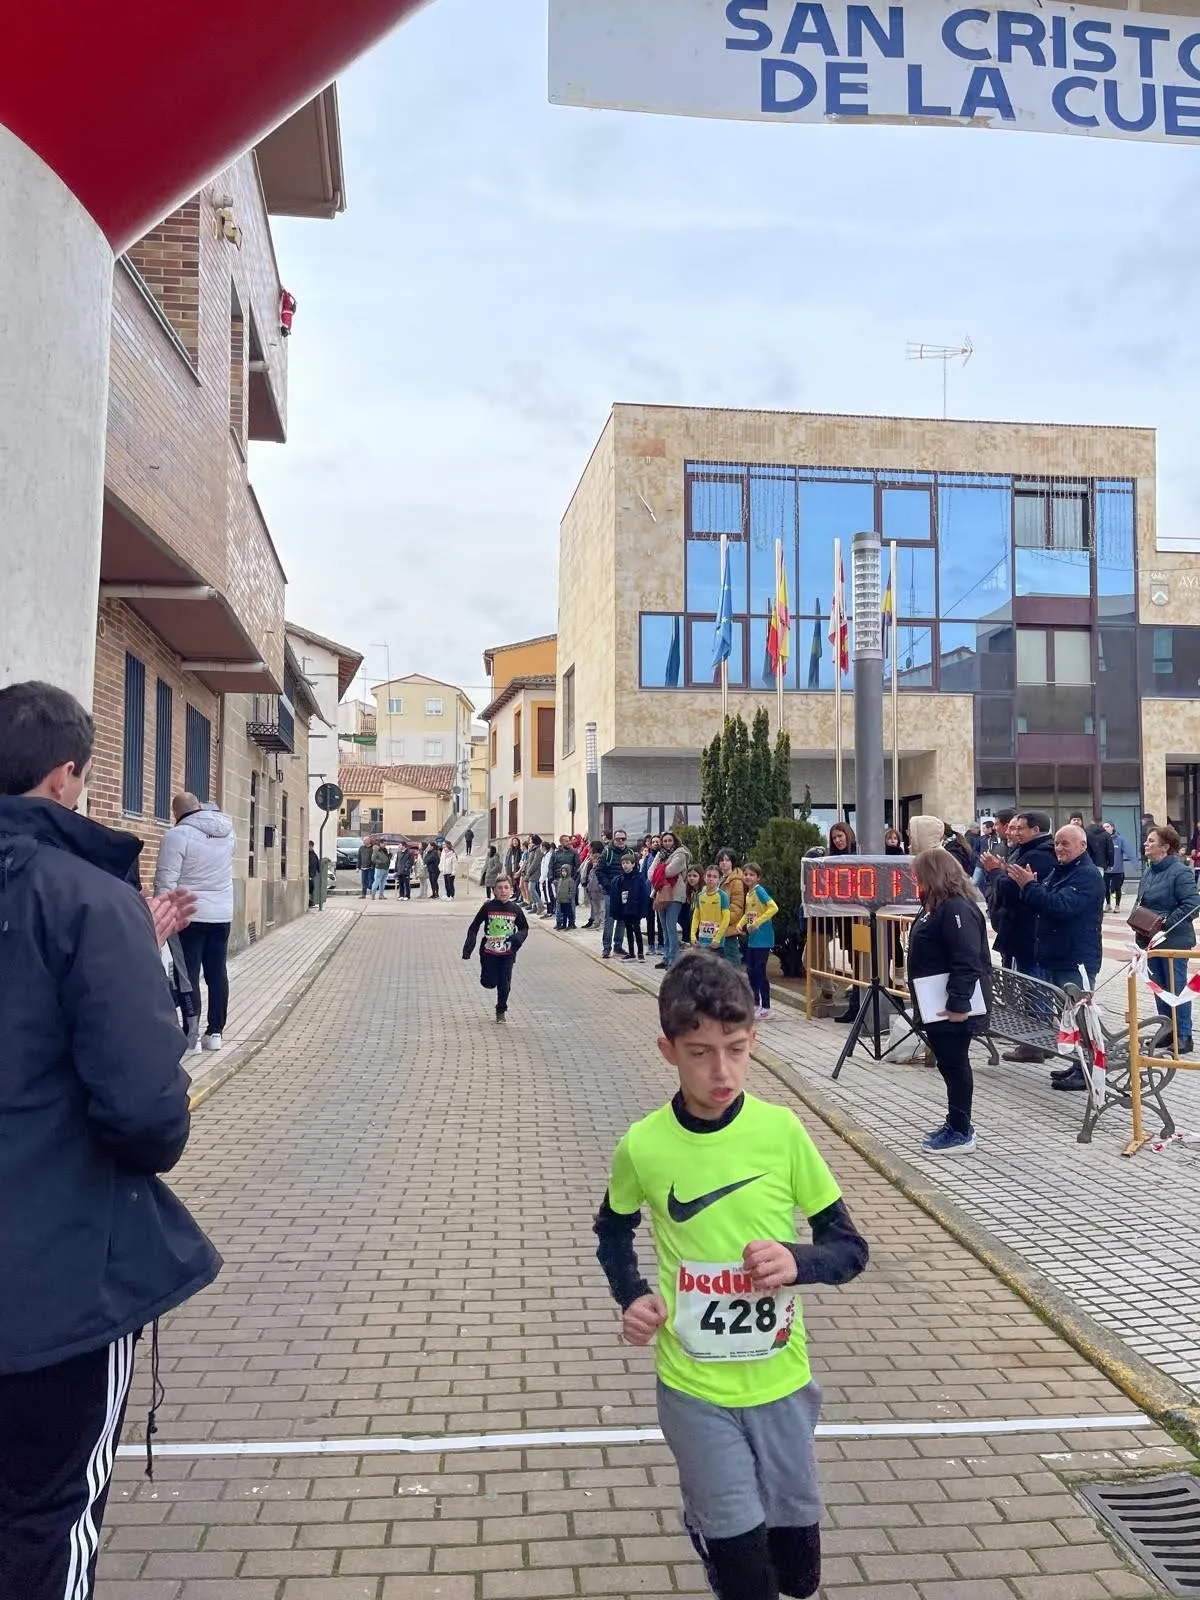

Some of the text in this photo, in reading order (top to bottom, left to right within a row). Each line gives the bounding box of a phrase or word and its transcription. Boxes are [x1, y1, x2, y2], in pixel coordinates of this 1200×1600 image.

[725, 0, 904, 58] SAN
[761, 58, 869, 116] DE
[907, 63, 1016, 122] LA
[700, 1296, 777, 1335] 428
